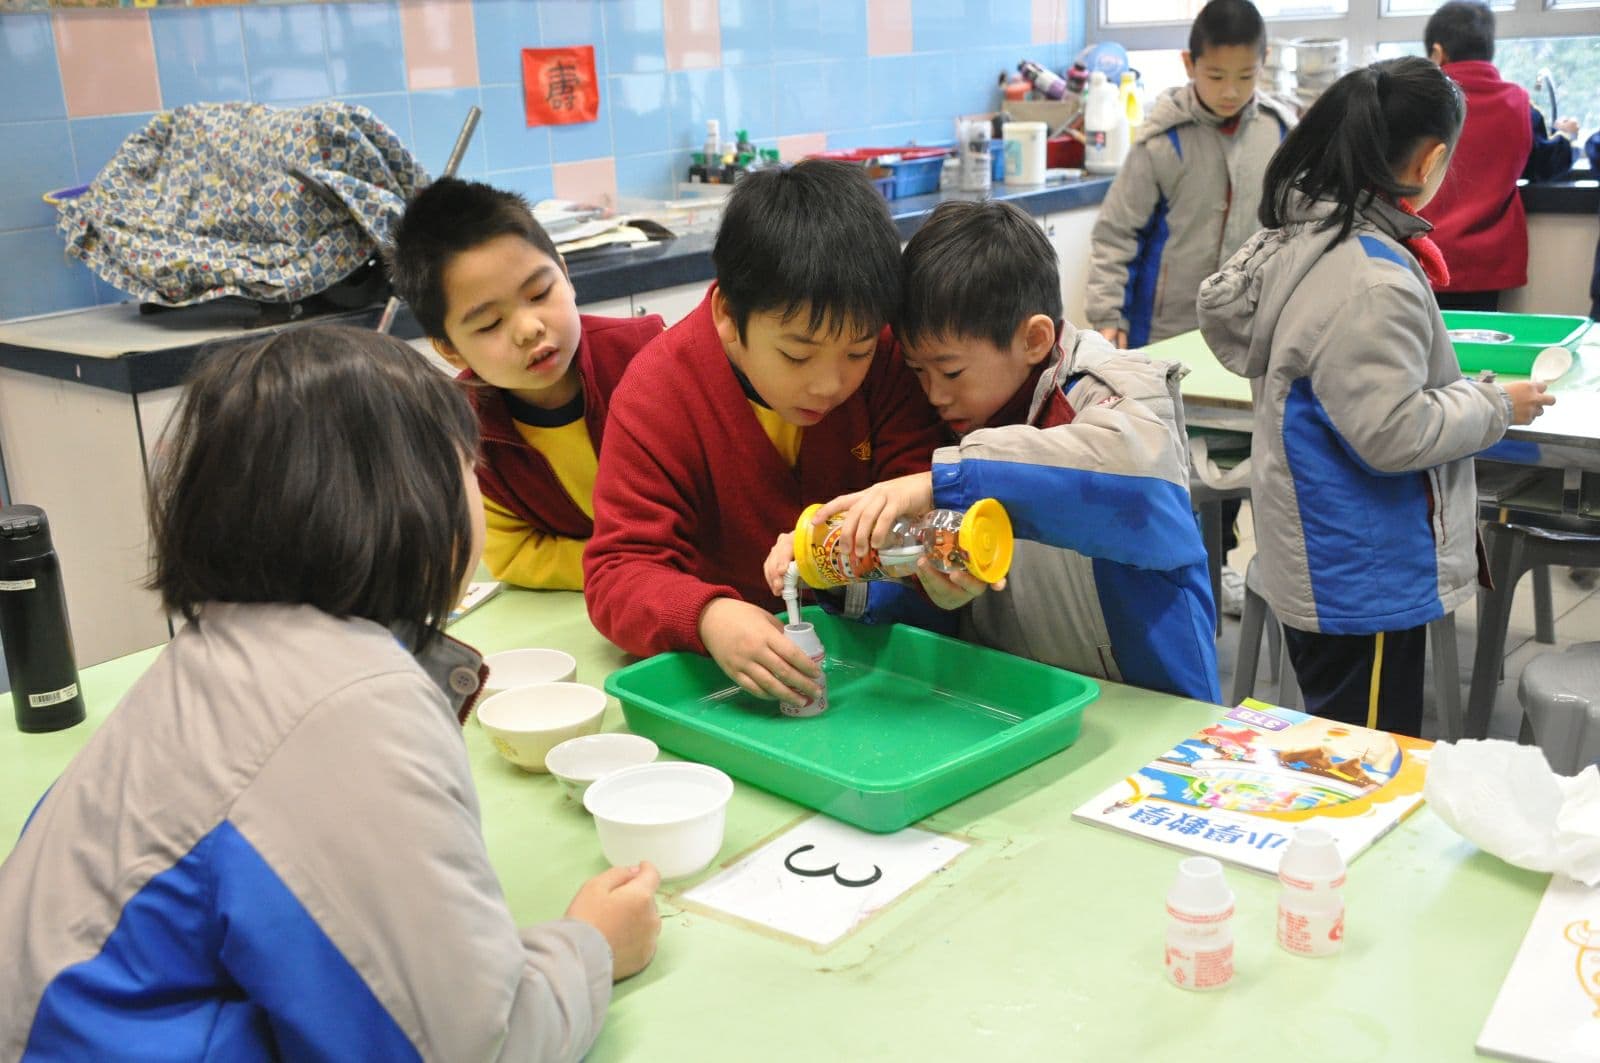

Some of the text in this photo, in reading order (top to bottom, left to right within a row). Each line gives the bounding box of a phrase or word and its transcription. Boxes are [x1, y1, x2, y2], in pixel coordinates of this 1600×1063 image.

[1129, 804, 1287, 849] 小學數學
[784, 845, 882, 887] 3
